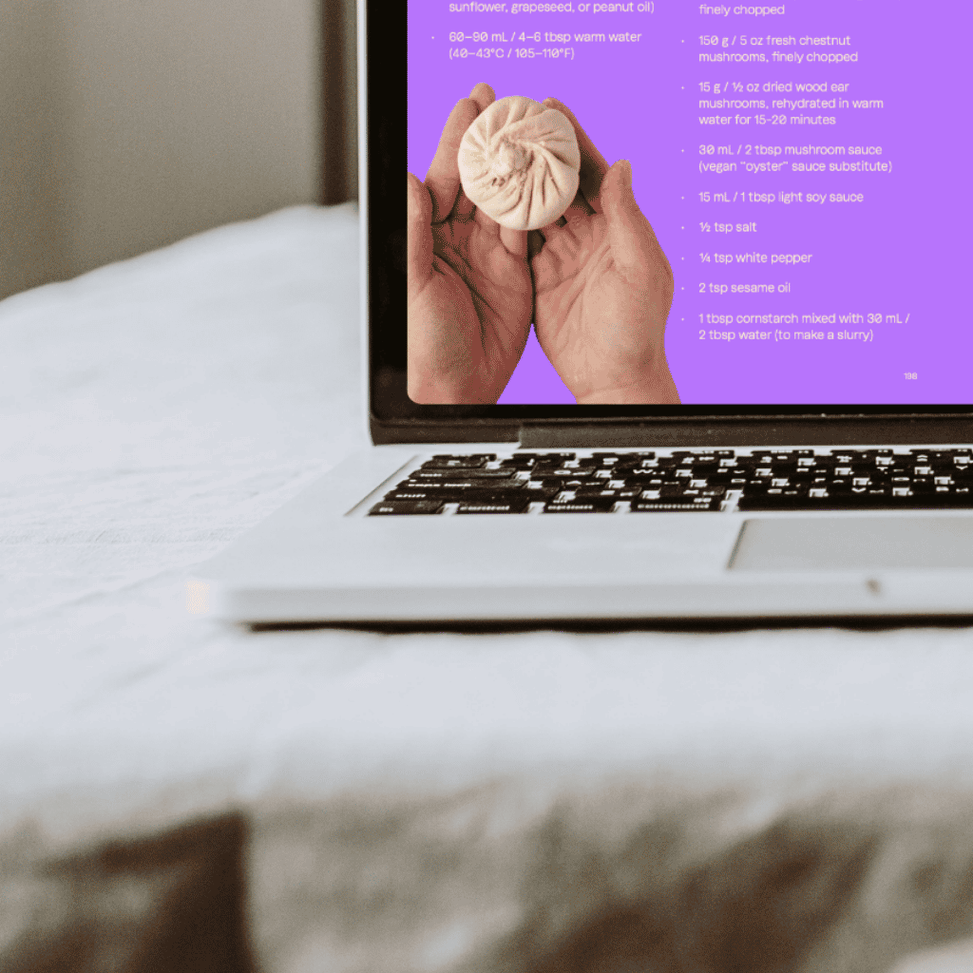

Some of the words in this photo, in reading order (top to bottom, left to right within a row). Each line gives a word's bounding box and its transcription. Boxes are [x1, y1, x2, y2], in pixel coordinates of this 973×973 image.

[448, 1, 509, 13] sunflower,
[510, 1, 576, 14] grapeseed,
[577, 3, 591, 12] or
[593, 2, 634, 14] peanut
[636, 1, 655, 14] oil)
[698, 4, 731, 17] finely
[733, 4, 785, 16] chopped
[698, 52, 769, 63] mushrooms,
[771, 51, 805, 64] finely
[805, 52, 859, 63] chopped
[698, 98, 769, 109] mushrooms,
[771, 98, 836, 110] rehydrated
[838, 97, 850, 108] in
[851, 100, 884, 108] warm
[698, 115, 733, 125] water
[734, 114, 752, 125] for
[753, 114, 788, 125] 15-20
[790, 114, 837, 125] minutes
[698, 161, 737, 173] (vegan
[791, 163, 827, 171] sauce
[828, 160, 893, 173] substitute)
[713, 253, 734, 265] tsp
[735, 252, 768, 263] white
[770, 254, 813, 265] pepper
[698, 283, 706, 293] 2
[708, 283, 729, 295] tsp
[730, 284, 775, 293] sesame
[777, 282, 791, 293] oil
